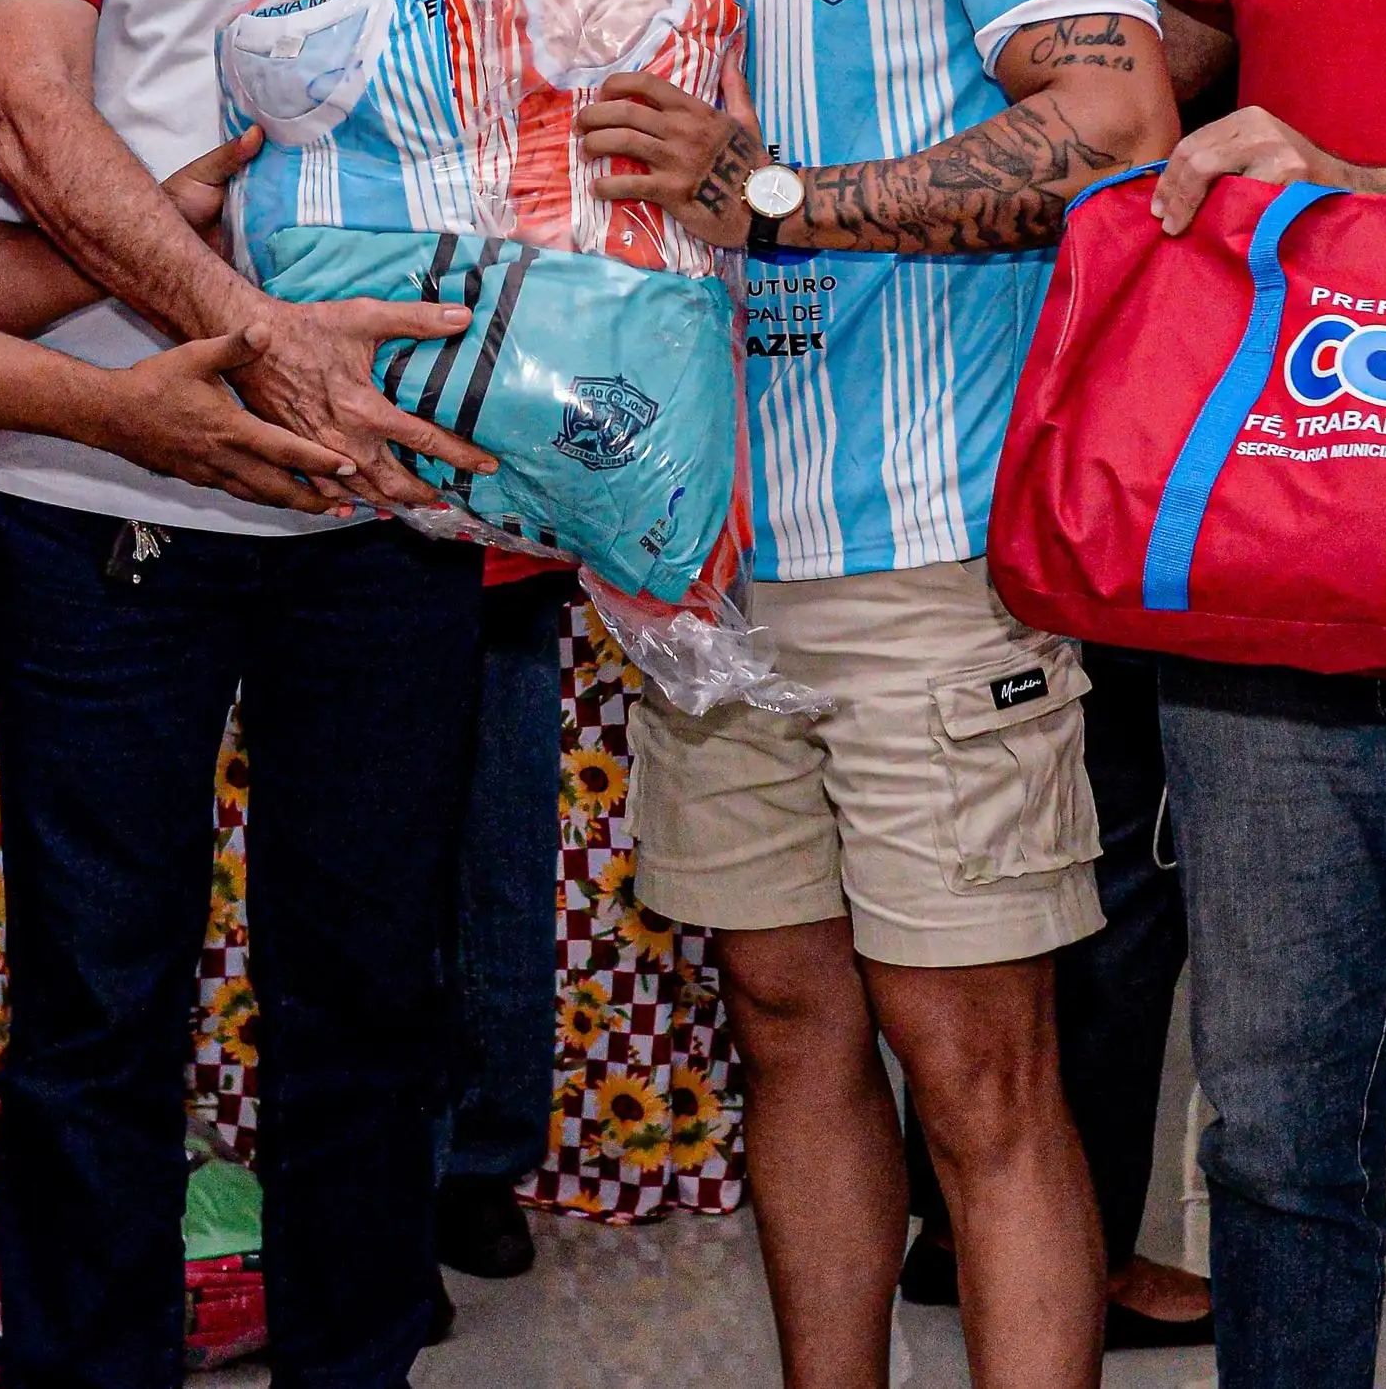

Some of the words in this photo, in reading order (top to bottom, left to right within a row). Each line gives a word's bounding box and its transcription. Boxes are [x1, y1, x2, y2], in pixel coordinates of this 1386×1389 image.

[748, 275, 837, 297] UTURO
[792, 304, 823, 322] DE
[1244, 414, 1286, 440] FÉ,
[1236, 441, 1328, 463] SECRETARIA
